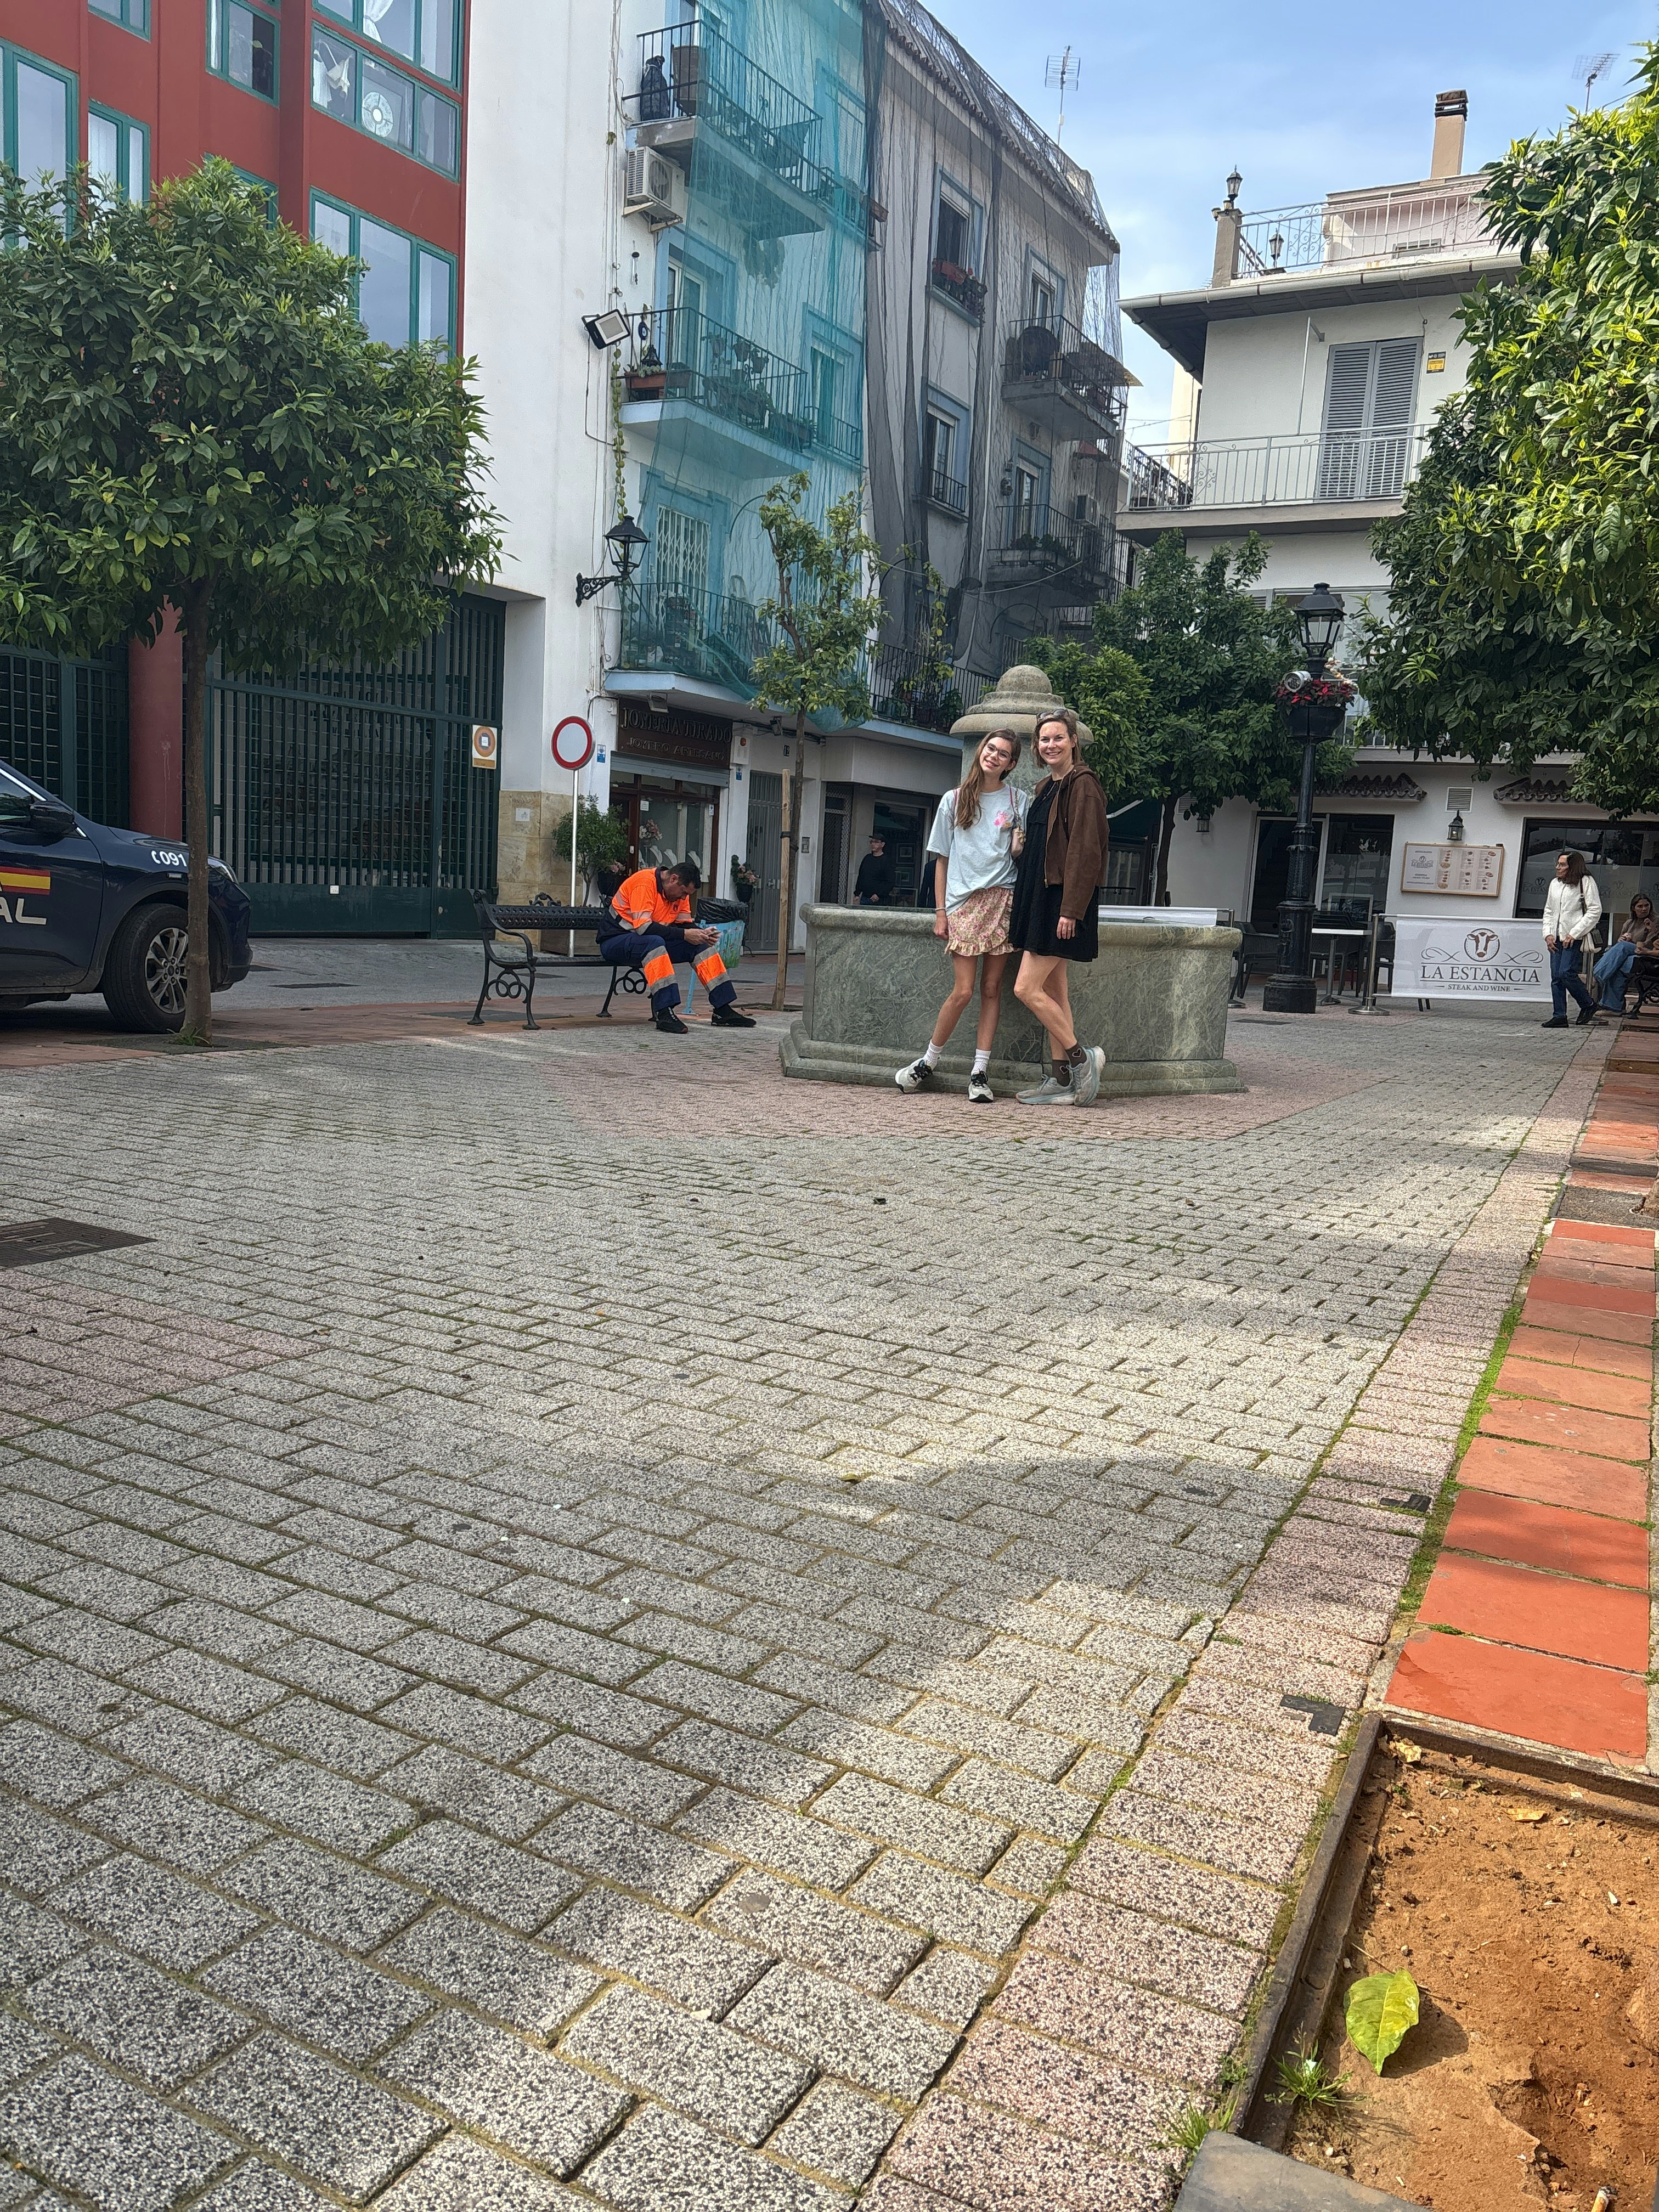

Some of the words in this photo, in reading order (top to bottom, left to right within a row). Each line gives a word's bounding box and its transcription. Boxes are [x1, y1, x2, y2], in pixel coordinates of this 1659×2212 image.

[620, 708, 682, 735] JOYERIA
[684, 720, 732, 743] TIRADO
[627, 737, 670, 752] JOYERO
[673, 746, 725, 761] ARTESANO
[1420, 965, 1444, 979] LA
[1449, 966, 1541, 983] ESTANCIA
